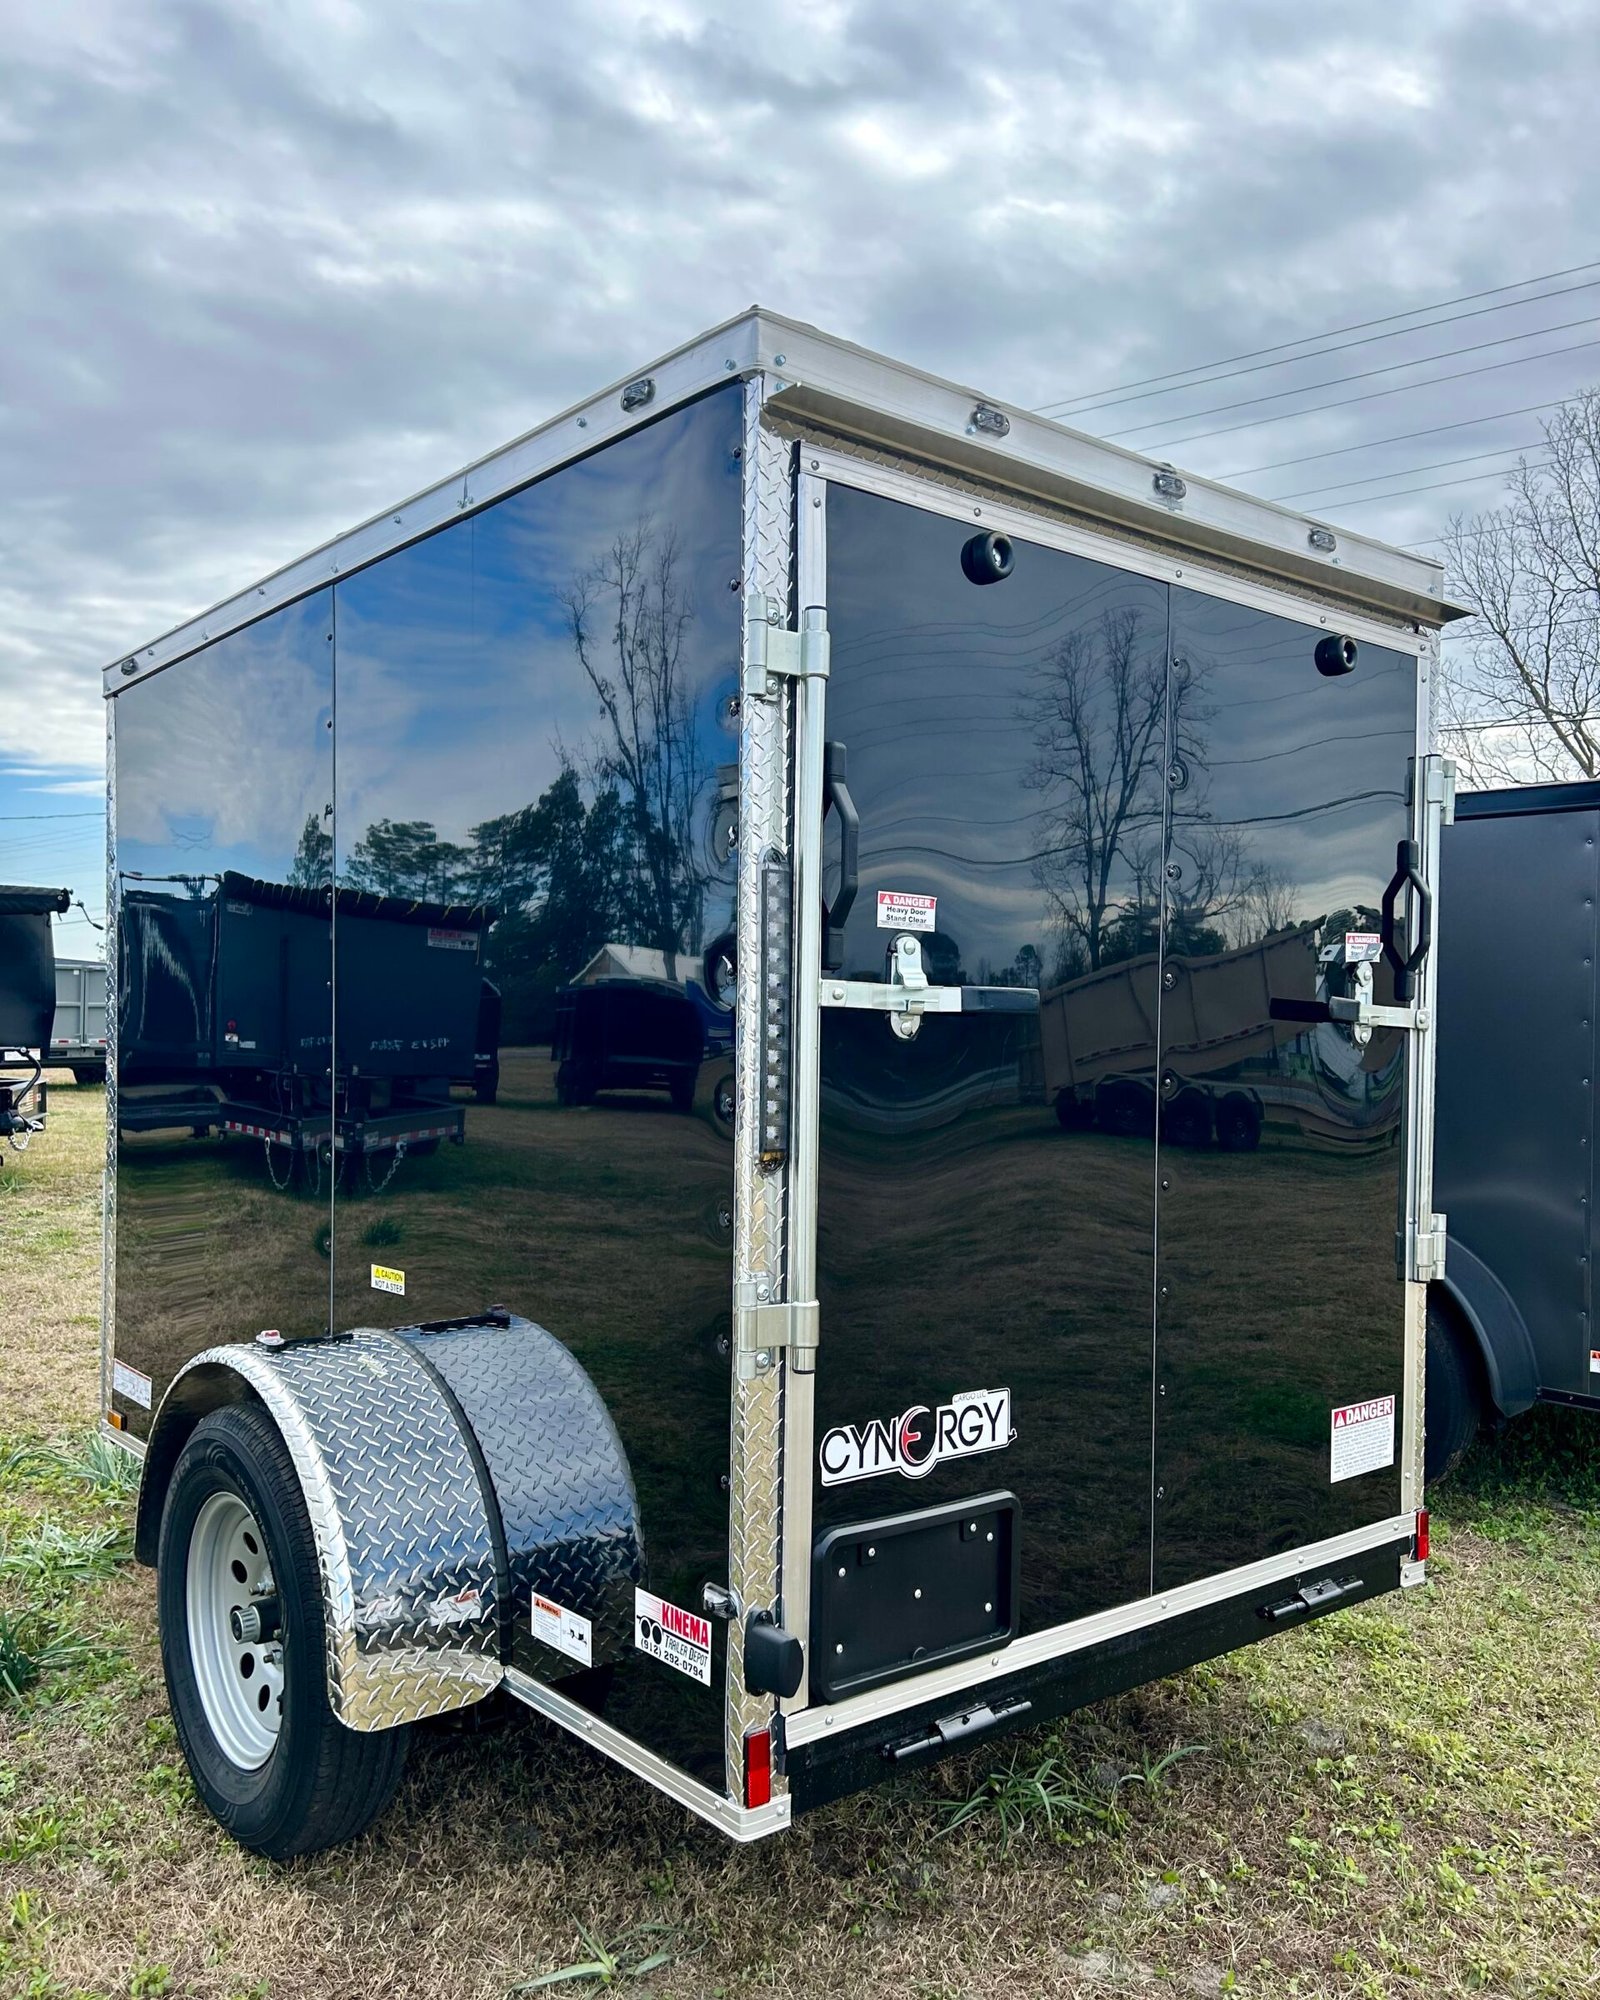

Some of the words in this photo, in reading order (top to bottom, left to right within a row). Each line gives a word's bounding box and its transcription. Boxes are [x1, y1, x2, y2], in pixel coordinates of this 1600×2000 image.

[893, 896, 931, 907] DANGER
[887, 906, 908, 915] Heavy
[910, 908, 927, 916] Door
[886, 914, 906, 922] Stand
[908, 916, 927, 924] Clear
[381, 1270, 403, 1282] CAUTION
[375, 1280, 385, 1288] NOT
[390, 1283, 403, 1292] STEP
[1346, 1399, 1392, 1425] DANGER
[662, 1602, 709, 1647] KINEMA
[665, 1635, 688, 1657] TRAILER
[688, 1647, 708, 1667] DEPOT
[641, 1638, 662, 1658] (912)
[664, 1651, 703, 1679] 292-0794
